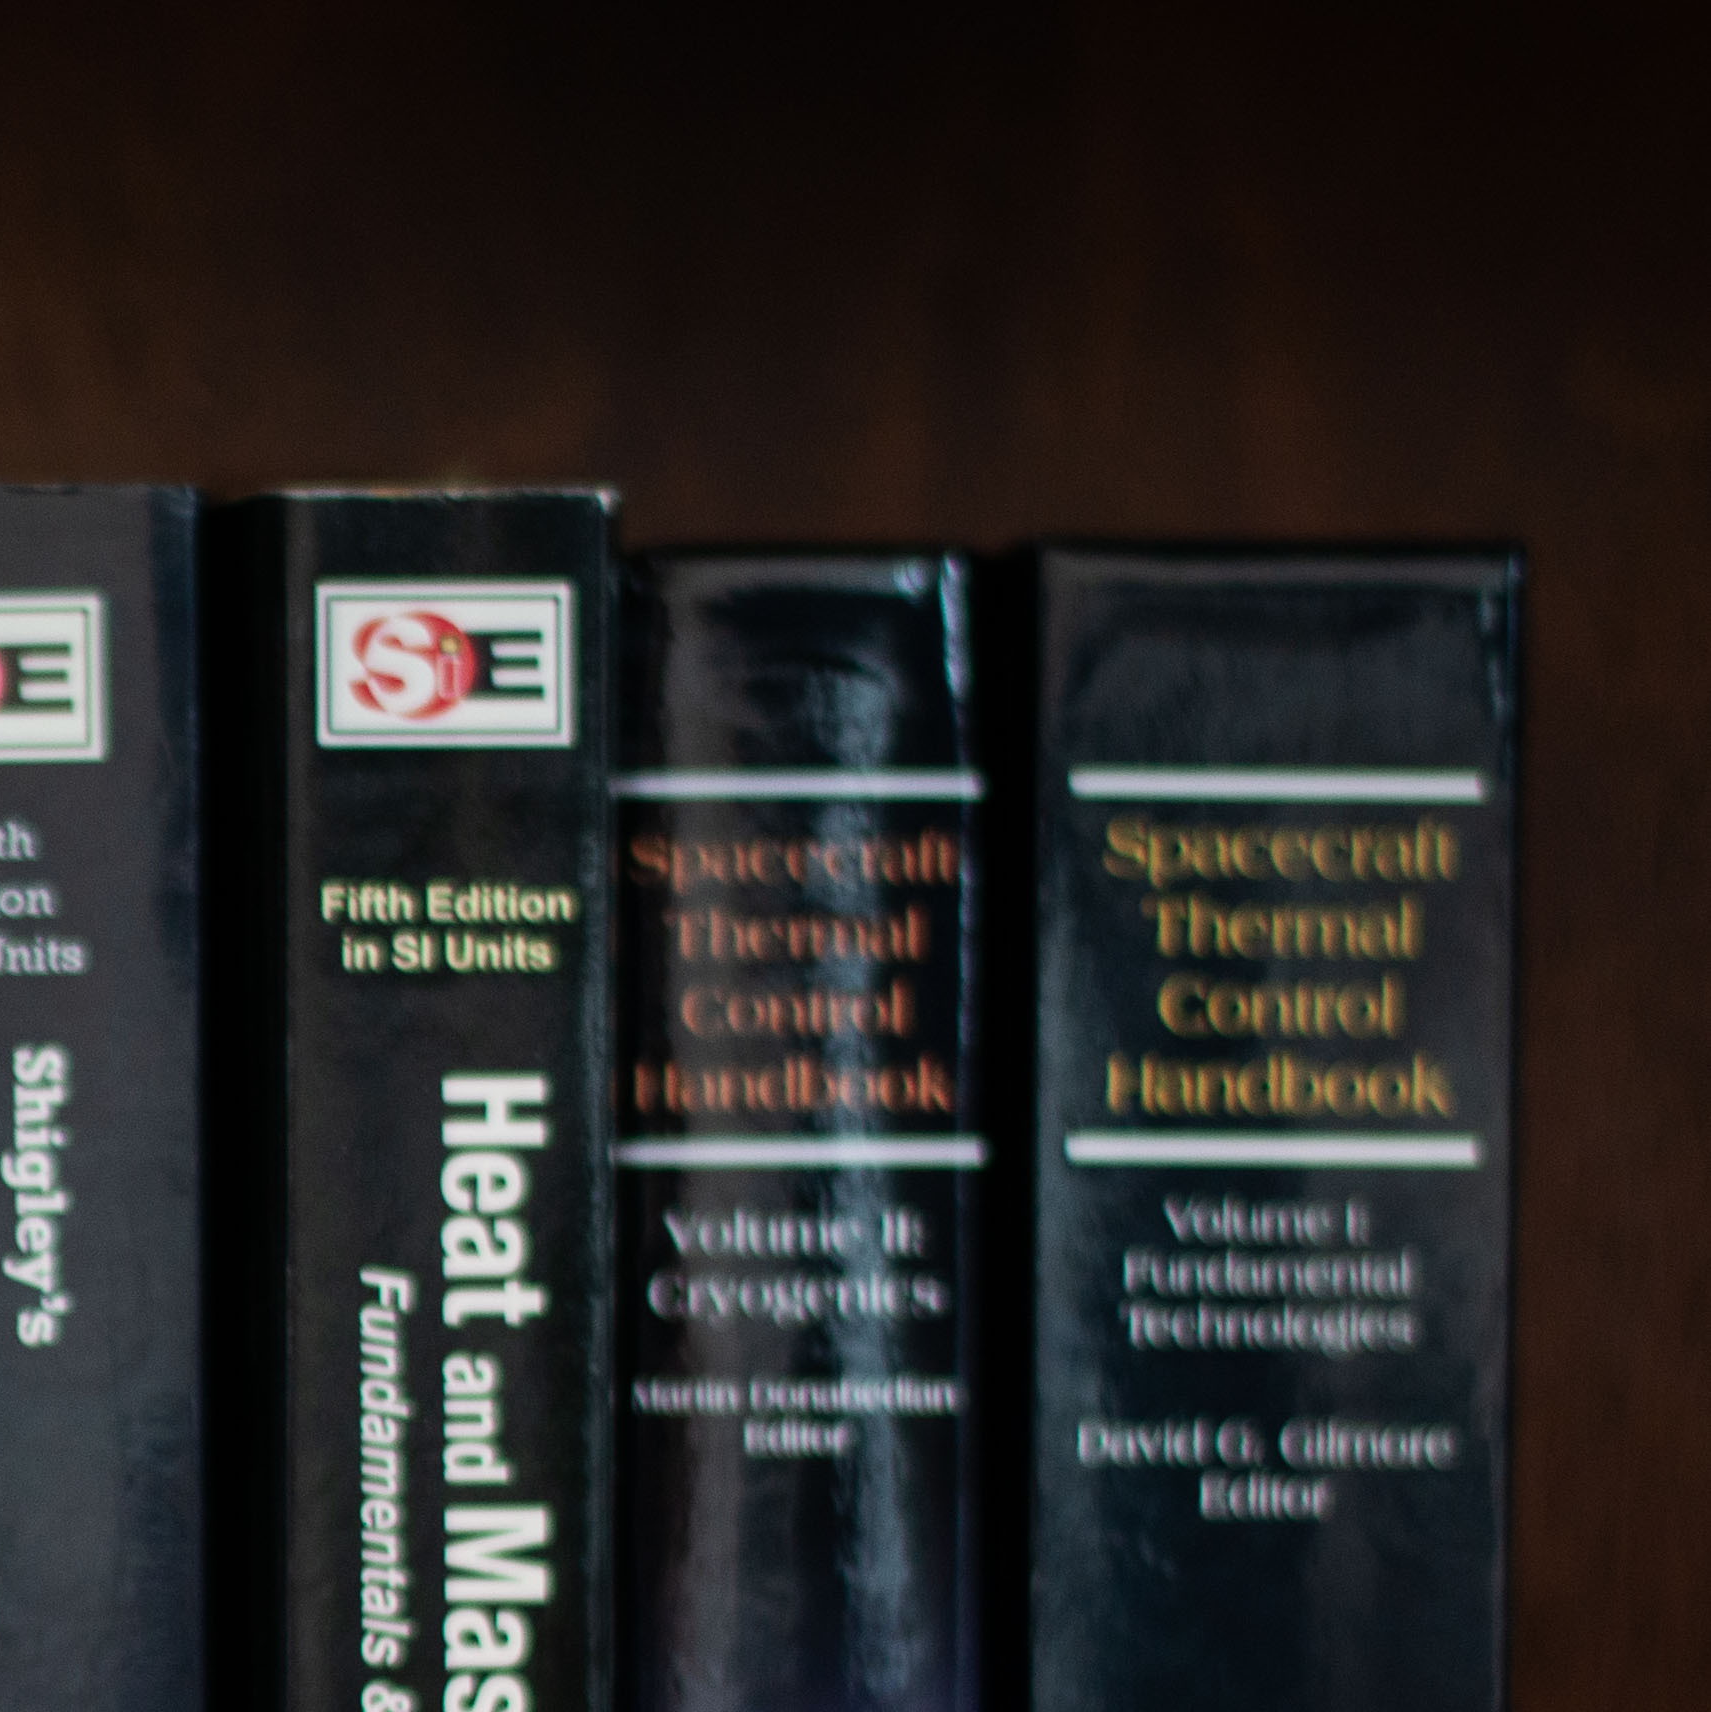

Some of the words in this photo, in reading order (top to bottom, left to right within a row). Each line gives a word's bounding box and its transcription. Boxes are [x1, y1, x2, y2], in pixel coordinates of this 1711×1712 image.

[630, 830, 960, 886] Spacecraft
[1102, 817, 1462, 887] Spacecraft
[321, 883, 413, 926] Fifth
[426, 882, 574, 923] Edition
[1143, 894, 1424, 959] Thermal
[341, 936, 378, 971] in
[390, 935, 437, 971] SI
[445, 934, 556, 971] Units
[669, 904, 929, 962] Thermal
[680, 979, 914, 1036] Control
[1157, 972, 1403, 1037] Control
[634, 1057, 956, 1114] Handbook
[1106, 1051, 1452, 1116] Handbook
[2, 1046, 71, 1347] Shigley's
[441, 1074, 546, 1327] Heat
[1164, 1194, 1333, 1244] Volume
[662, 1207, 861, 1255] Volume
[648, 1270, 950, 1328] Cryogenics
[1123, 1247, 1415, 1296] Fundamental
[1120, 1301, 1417, 1358] Technologies
[443, 1355, 511, 1483] and
[744, 1421, 849, 1457] Editor
[1078, 1417, 1205, 1468] David
[1279, 1417, 1456, 1470] Gilmore
[359, 1268, 413, 1670] Fundamentals
[1199, 1472, 1331, 1520] Editor
